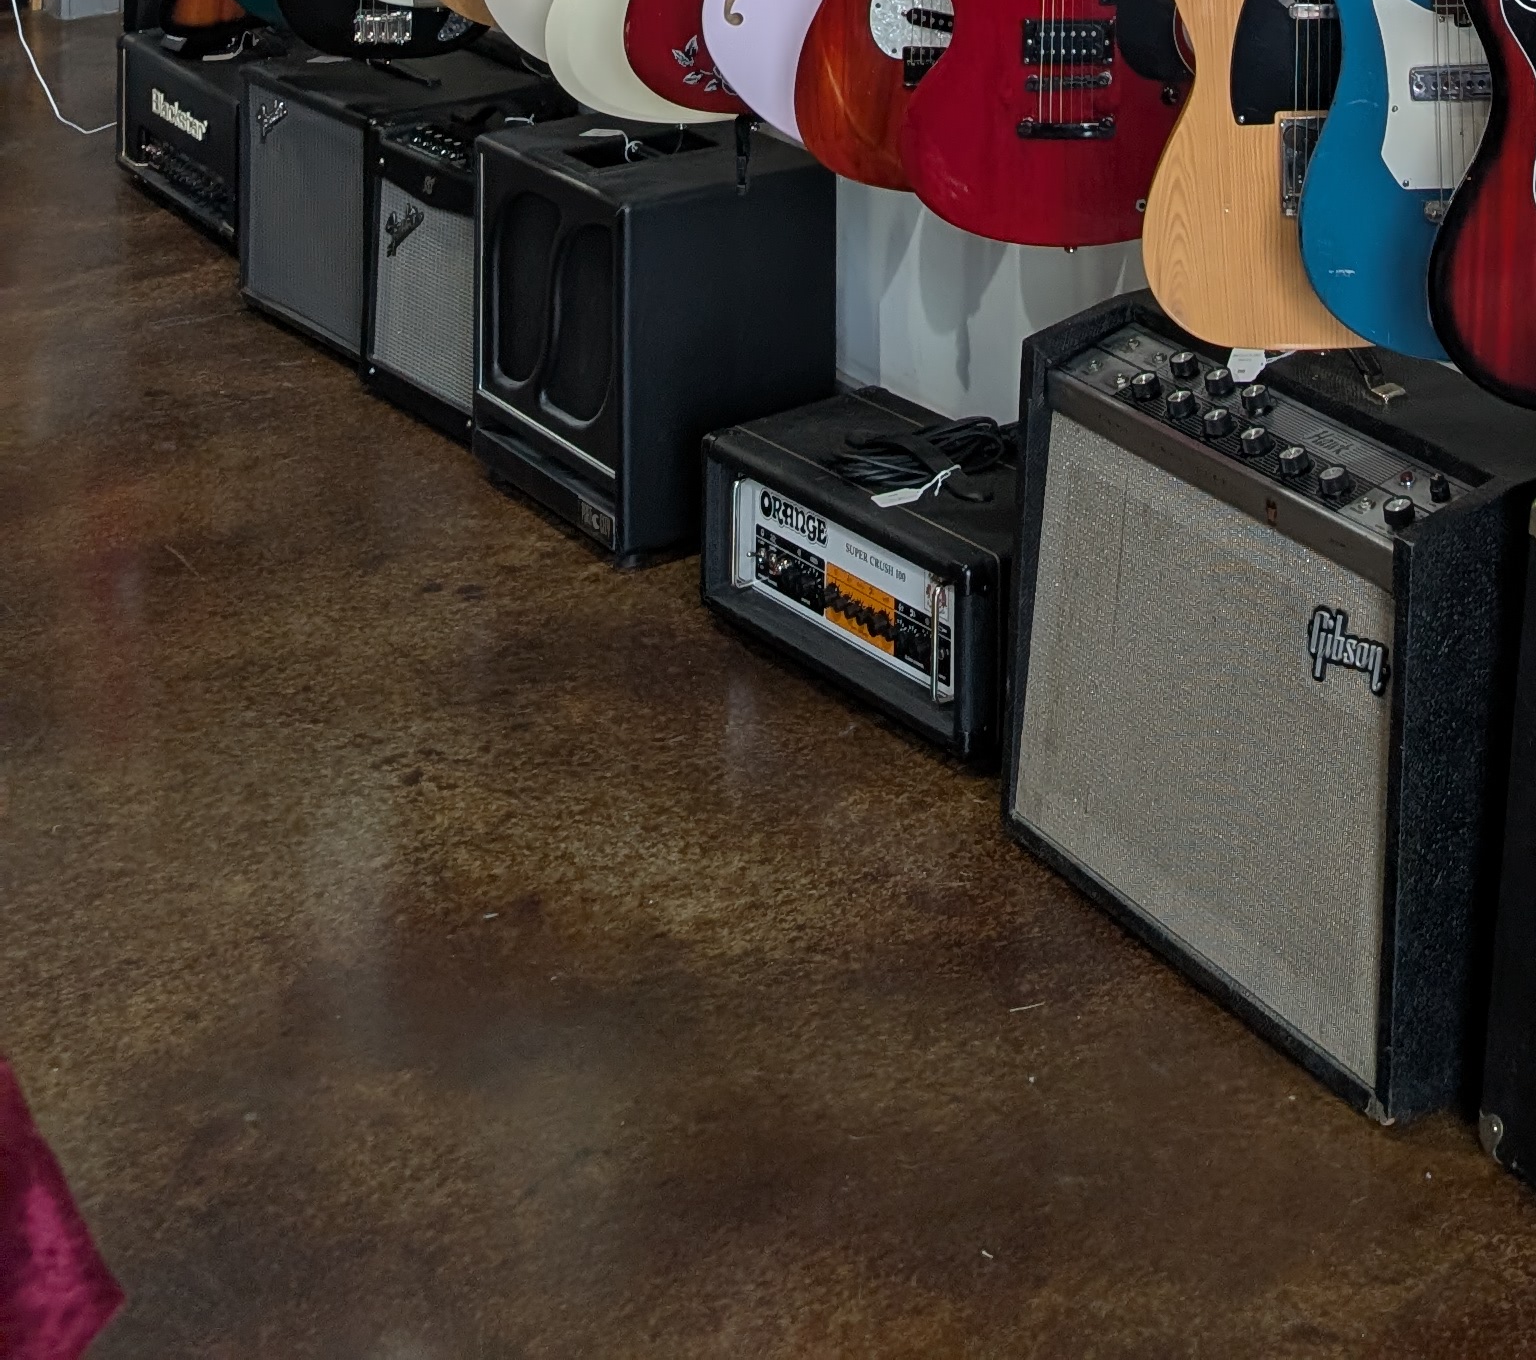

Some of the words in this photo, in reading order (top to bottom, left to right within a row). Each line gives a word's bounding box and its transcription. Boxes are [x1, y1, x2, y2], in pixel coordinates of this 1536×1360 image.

[150, 88, 209, 142] Blackstar
[760, 489, 828, 547] ORANGE
[845, 542, 869, 563] SUPER
[869, 556, 895, 577] CRUSH
[1309, 610, 1383, 693] Gibson
